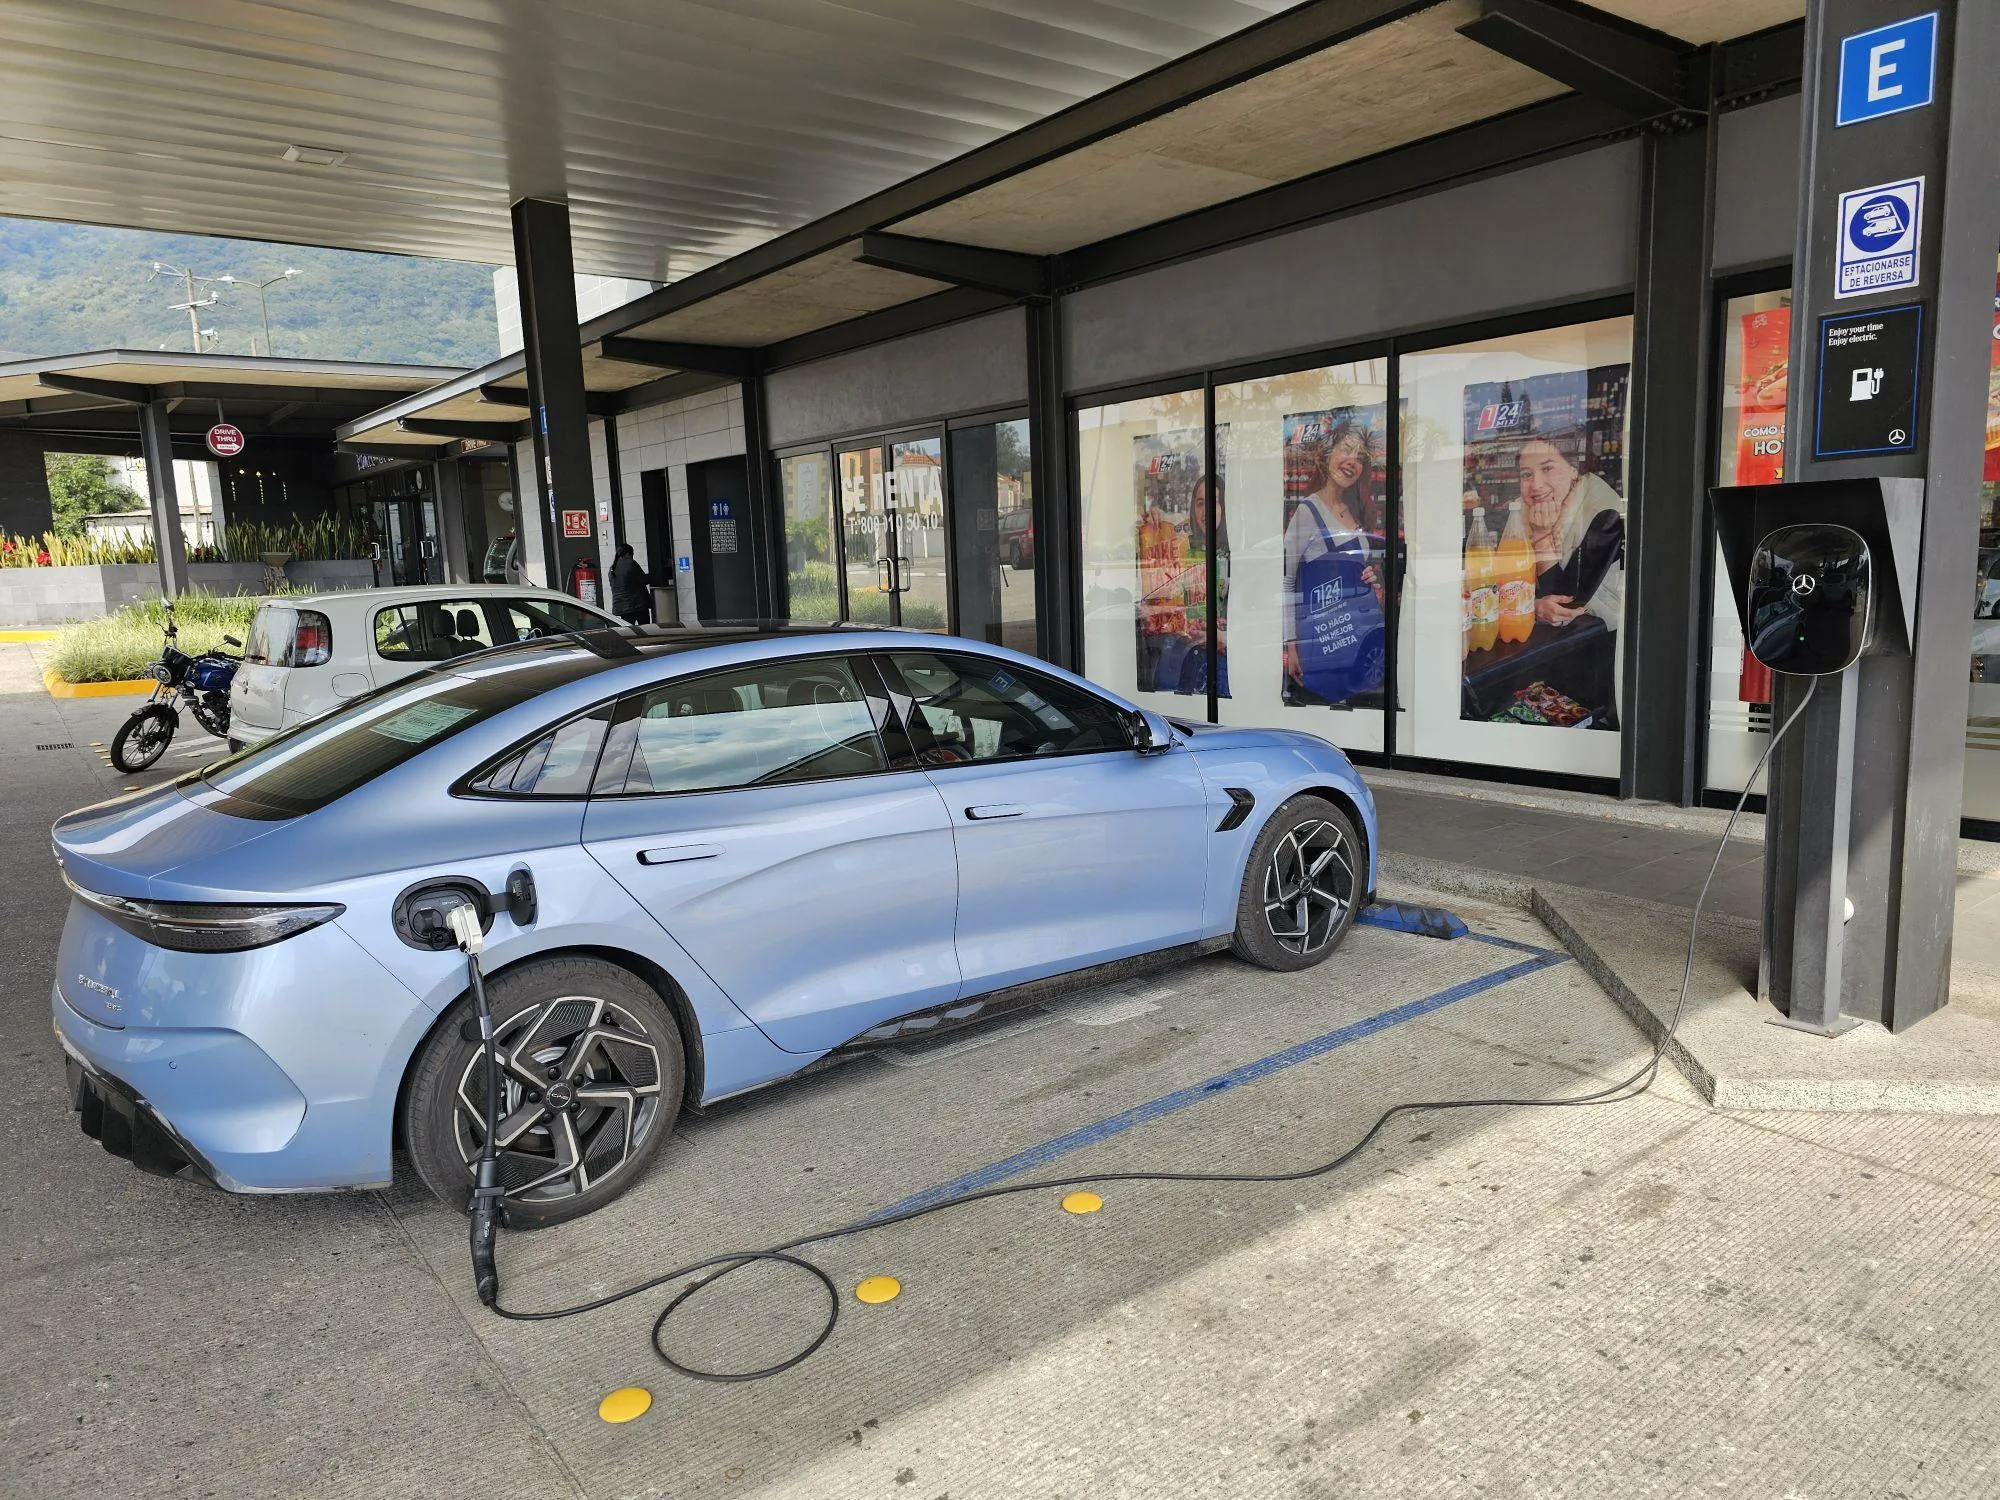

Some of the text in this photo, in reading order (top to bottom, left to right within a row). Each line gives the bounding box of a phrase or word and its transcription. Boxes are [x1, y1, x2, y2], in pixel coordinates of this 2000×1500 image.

[1867, 38, 1905, 103] E
[1849, 270, 1904, 288] DE REVERSA
[1828, 323, 1884, 337] Enjoy your time
[1828, 333, 1878, 346] Enjoy electric.
[1498, 403, 1520, 420] 24
[1743, 425, 1778, 438] COMO
[1160, 455, 1174, 468] 24
[841, 475, 866, 514] SE
[870, 465, 944, 517] RENTA
[860, 515, 880, 534] 800
[906, 512, 920, 531] 50
[1325, 580, 1341, 600] 24
[1314, 613, 1352, 634] YO HAGO
[1319, 623, 1354, 643] UN MEJOR
[1322, 634, 1358, 655] PLANETA
